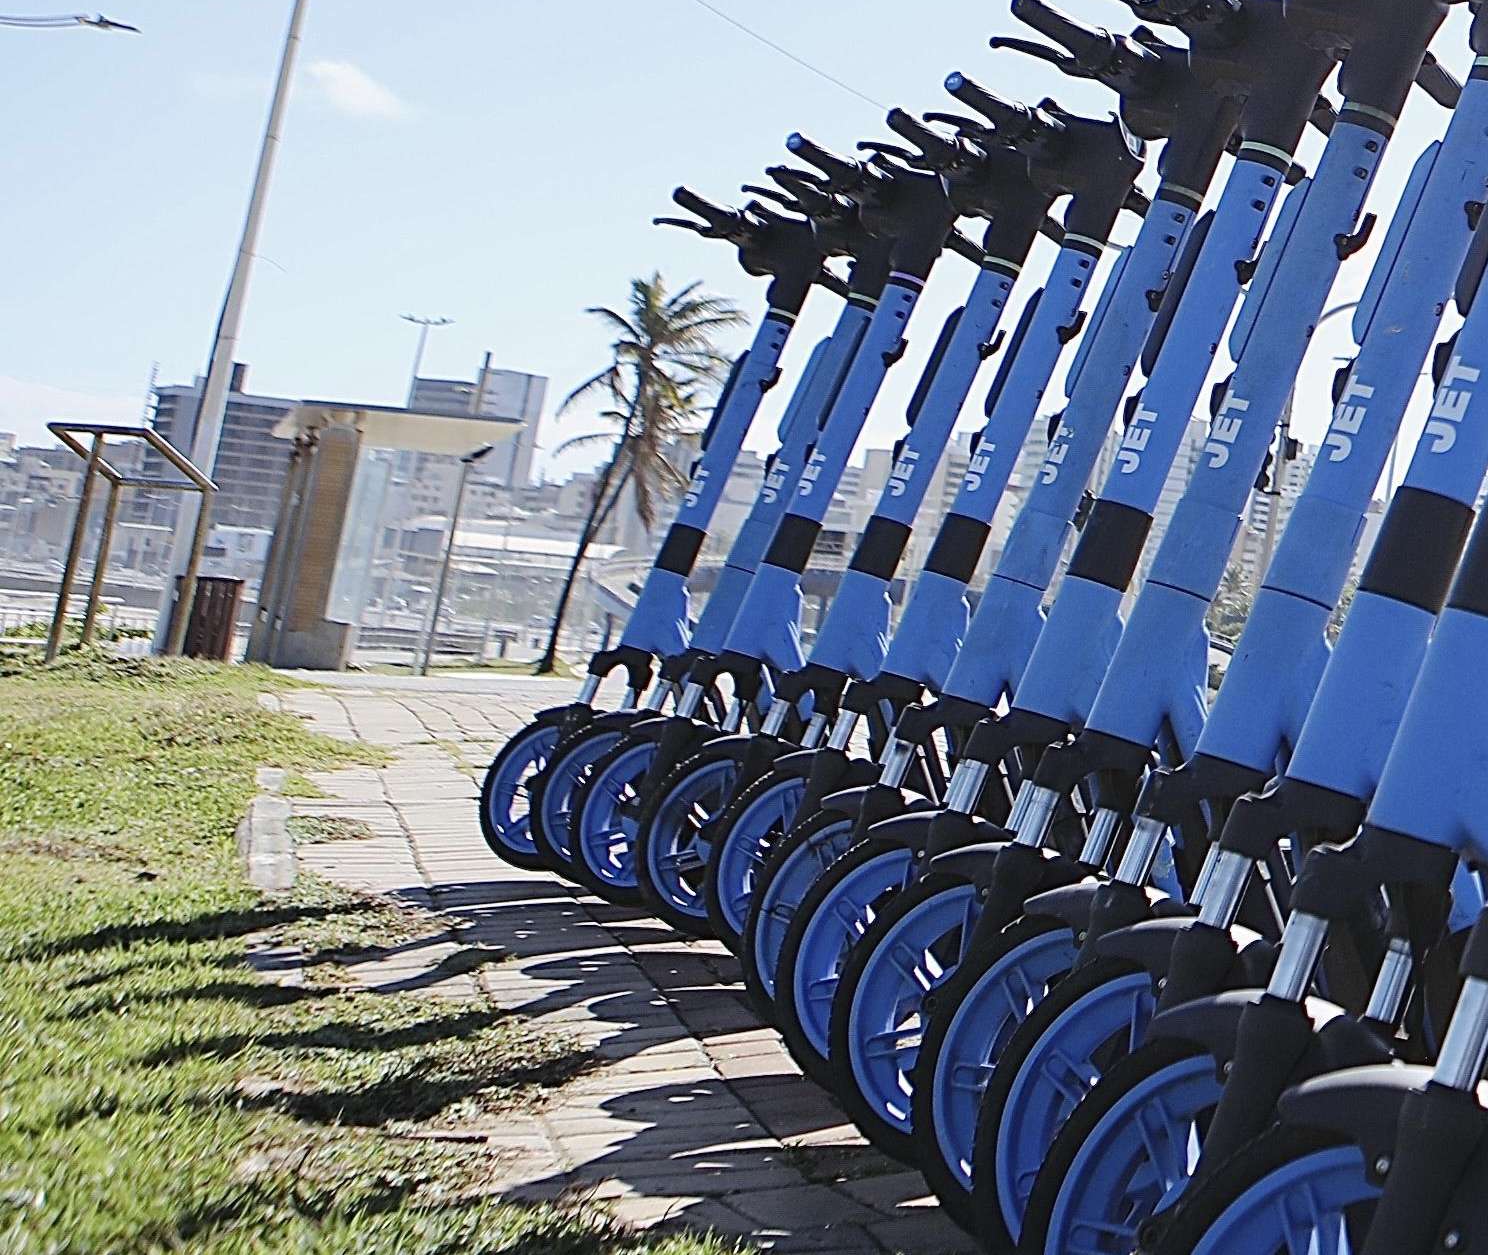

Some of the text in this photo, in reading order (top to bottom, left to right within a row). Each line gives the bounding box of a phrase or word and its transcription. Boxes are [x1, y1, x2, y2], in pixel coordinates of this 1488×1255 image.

[1205, 389, 1250, 469] JET
[1325, 374, 1375, 462] JET
[1424, 355, 1480, 454] JET
[964, 436, 996, 492] JET
[1039, 420, 1074, 485] JET
[1117, 403, 1158, 474] JET
[684, 464, 710, 507] JET
[762, 457, 790, 504] JET
[798, 448, 827, 496] JET
[888, 444, 920, 497] JET
